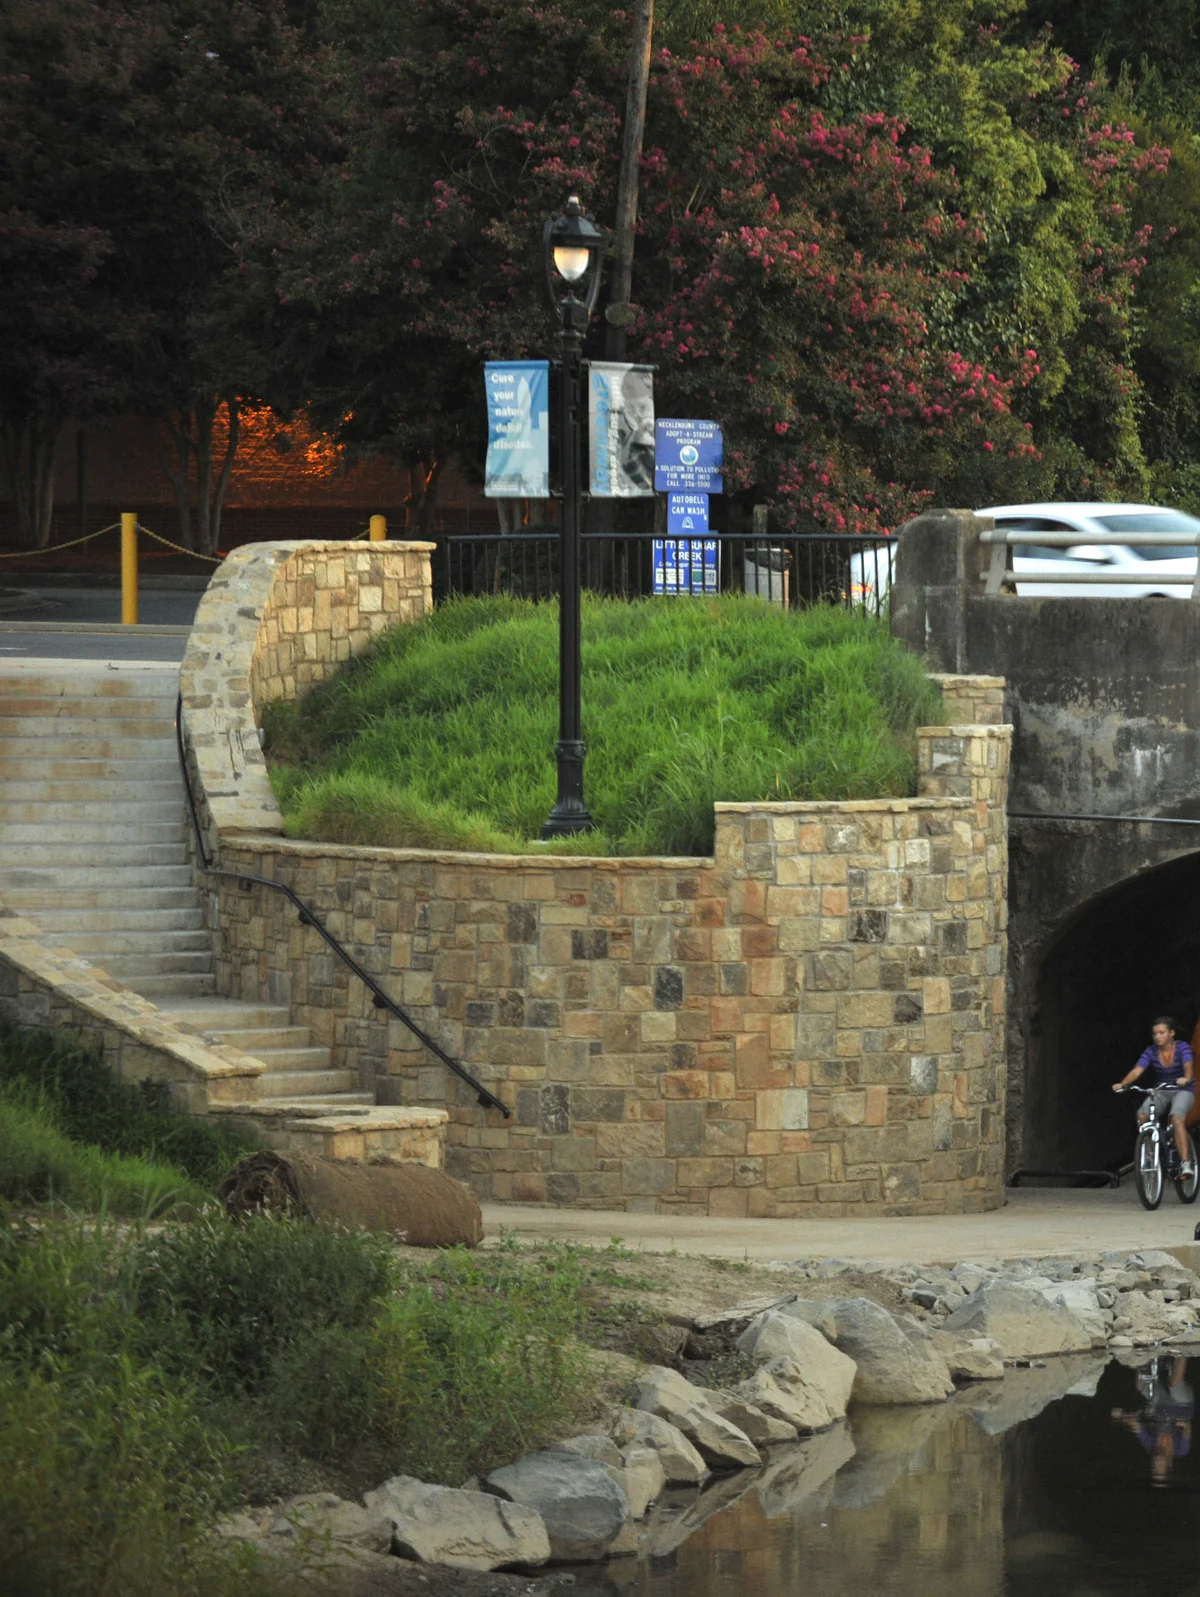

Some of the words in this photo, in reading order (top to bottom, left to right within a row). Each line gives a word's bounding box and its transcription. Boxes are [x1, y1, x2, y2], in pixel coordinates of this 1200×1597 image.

[491, 372, 514, 384] Cure
[493, 391, 514, 402] your
[658, 421, 695, 429] MECKLENBURG
[592, 373, 610, 495] greenway
[672, 495, 704, 504] AUTOBELL
[672, 506, 685, 514] CAR
[687, 506, 705, 515] WASH
